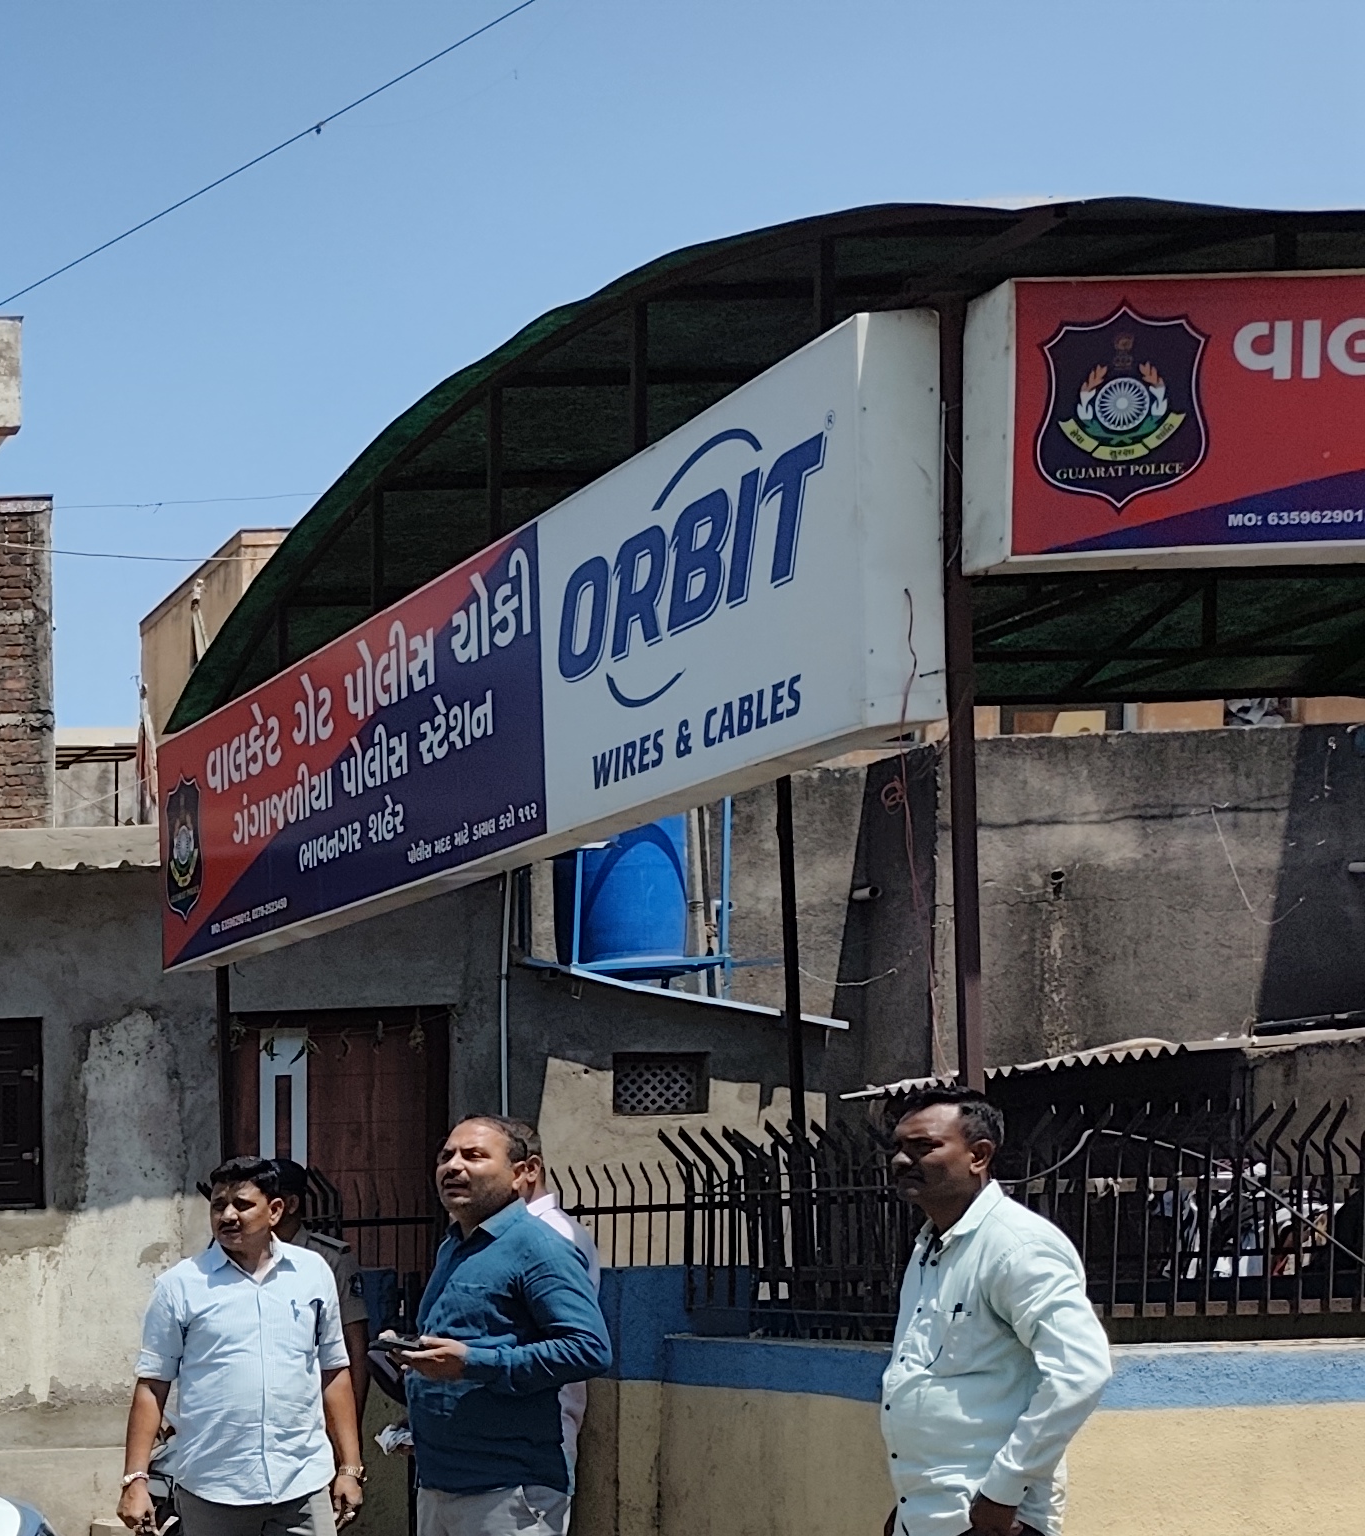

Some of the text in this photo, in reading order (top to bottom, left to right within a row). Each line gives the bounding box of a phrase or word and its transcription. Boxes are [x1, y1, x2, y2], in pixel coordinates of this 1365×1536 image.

[1055, 462, 1185, 480] GUJARAT POLICE
[558, 431, 827, 683] ORBIT
[1228, 513, 1262, 527] MO:
[206, 547, 532, 794] વાલકેટ ગેટ પોલીસ ચોકી
[233, 689, 494, 845] ગંગાજળીયા પોલીસ સ્ટેશન
[592, 673, 802, 790] WIRES & CABLES
[298, 794, 405, 872] ભાવનગર શહેર
[407, 802, 539, 864] પોલીસ મદદ માટે ડાયલ કરો ૧૧૨
